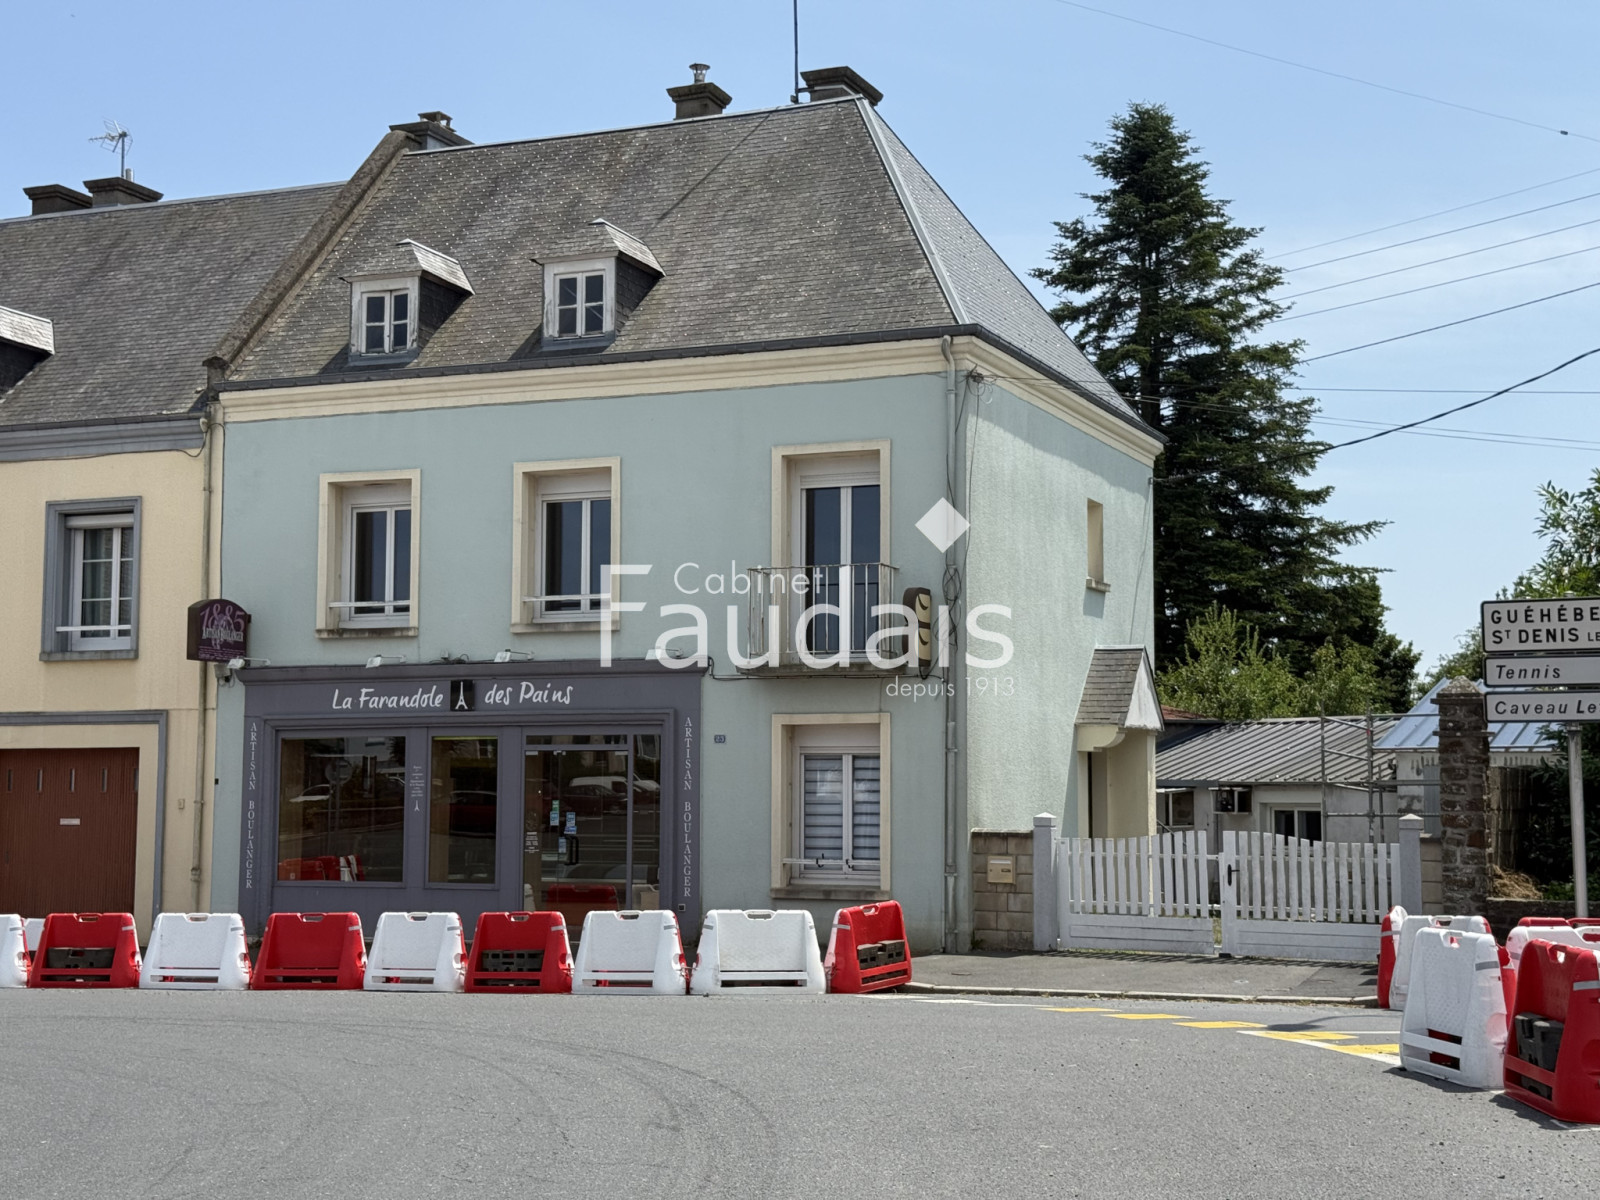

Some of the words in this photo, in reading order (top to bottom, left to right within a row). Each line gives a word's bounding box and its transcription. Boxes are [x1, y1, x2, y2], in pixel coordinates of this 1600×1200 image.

[1518, 627, 1580, 644] DENIS
[332, 688, 352, 710] La
[359, 685, 444, 710] Farandole
[484, 683, 513, 705] des
[519, 681, 574, 705] Pains
[1495, 664, 1562, 680] Tennis
[1494, 700, 1568, 715] Caveau
[1576, 699, 1600, 714] Le
[248, 722, 258, 790] ARTISAN
[683, 716, 693, 790] ARTISAN
[245, 800, 255, 888] BOULANGER
[683, 801, 692, 897] BOULANGER
